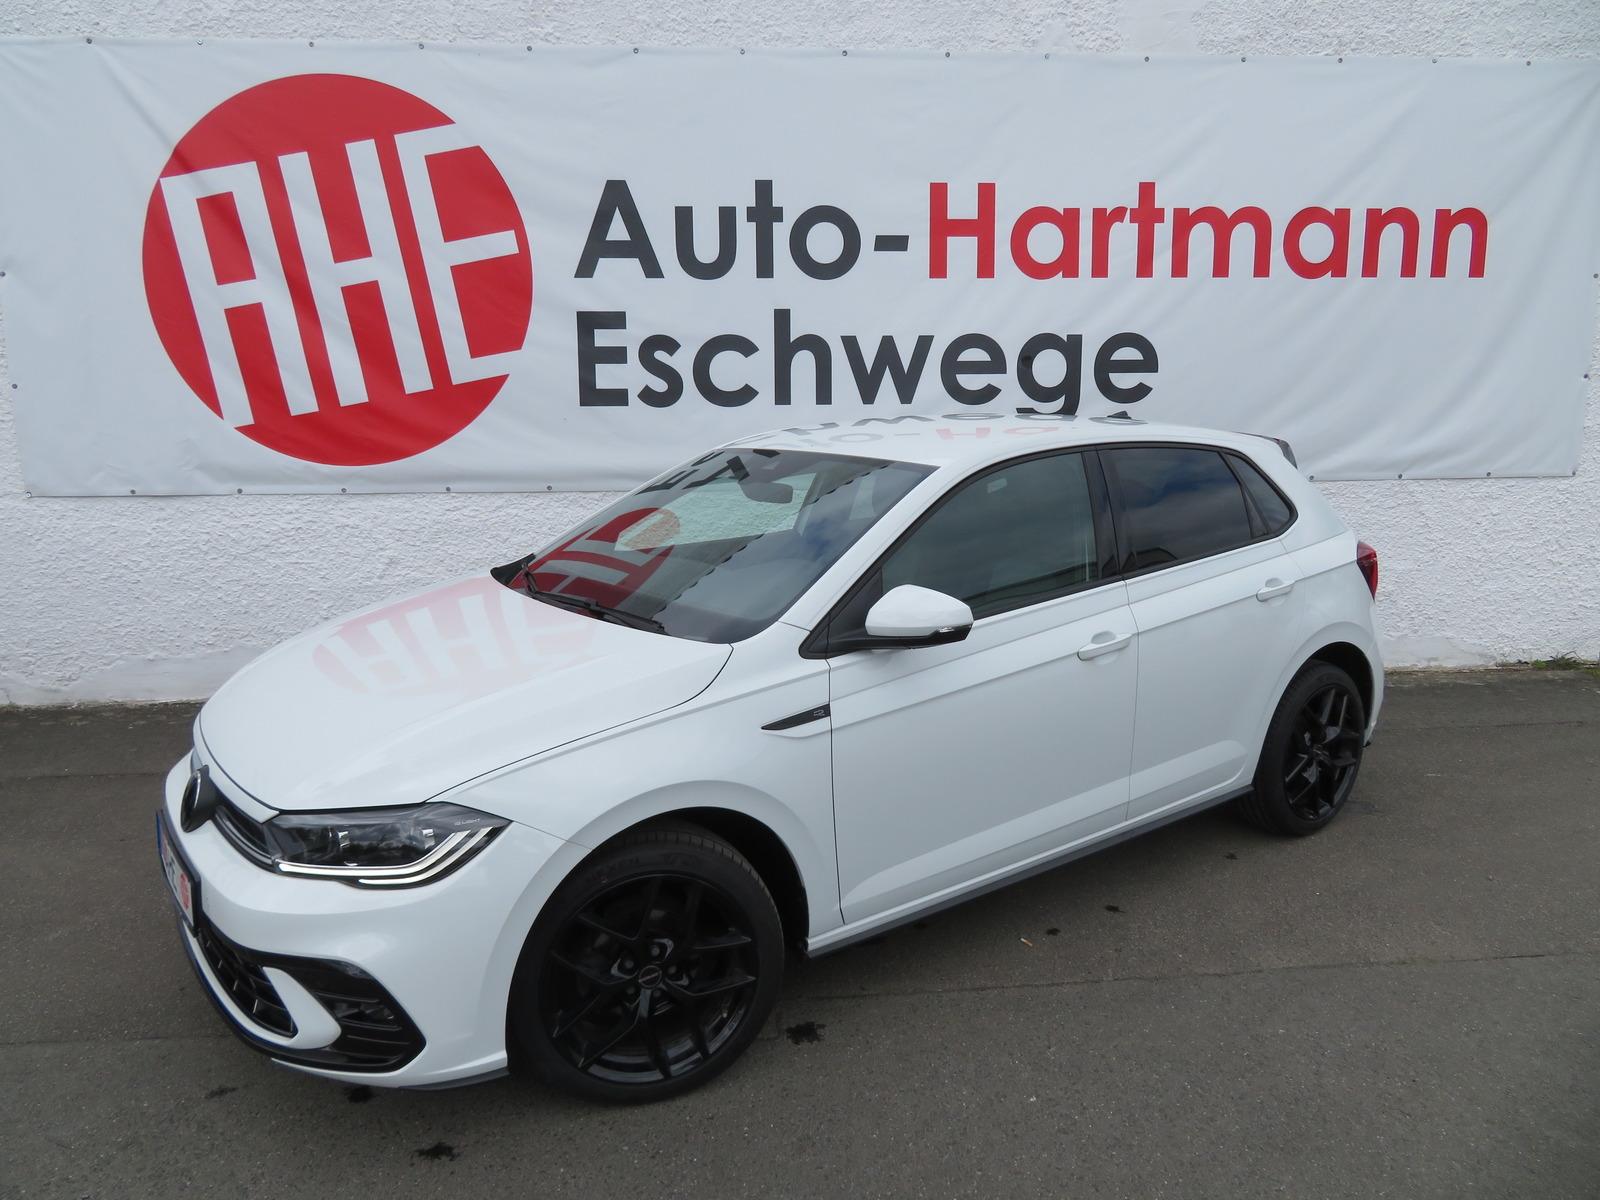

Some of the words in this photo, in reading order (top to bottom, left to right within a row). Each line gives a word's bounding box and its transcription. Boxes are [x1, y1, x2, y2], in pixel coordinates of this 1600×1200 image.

[159, 123, 519, 428] AHE
[575, 180, 1488, 280] Auto-Hartmann
[577, 309, 1159, 416] Eschwege
